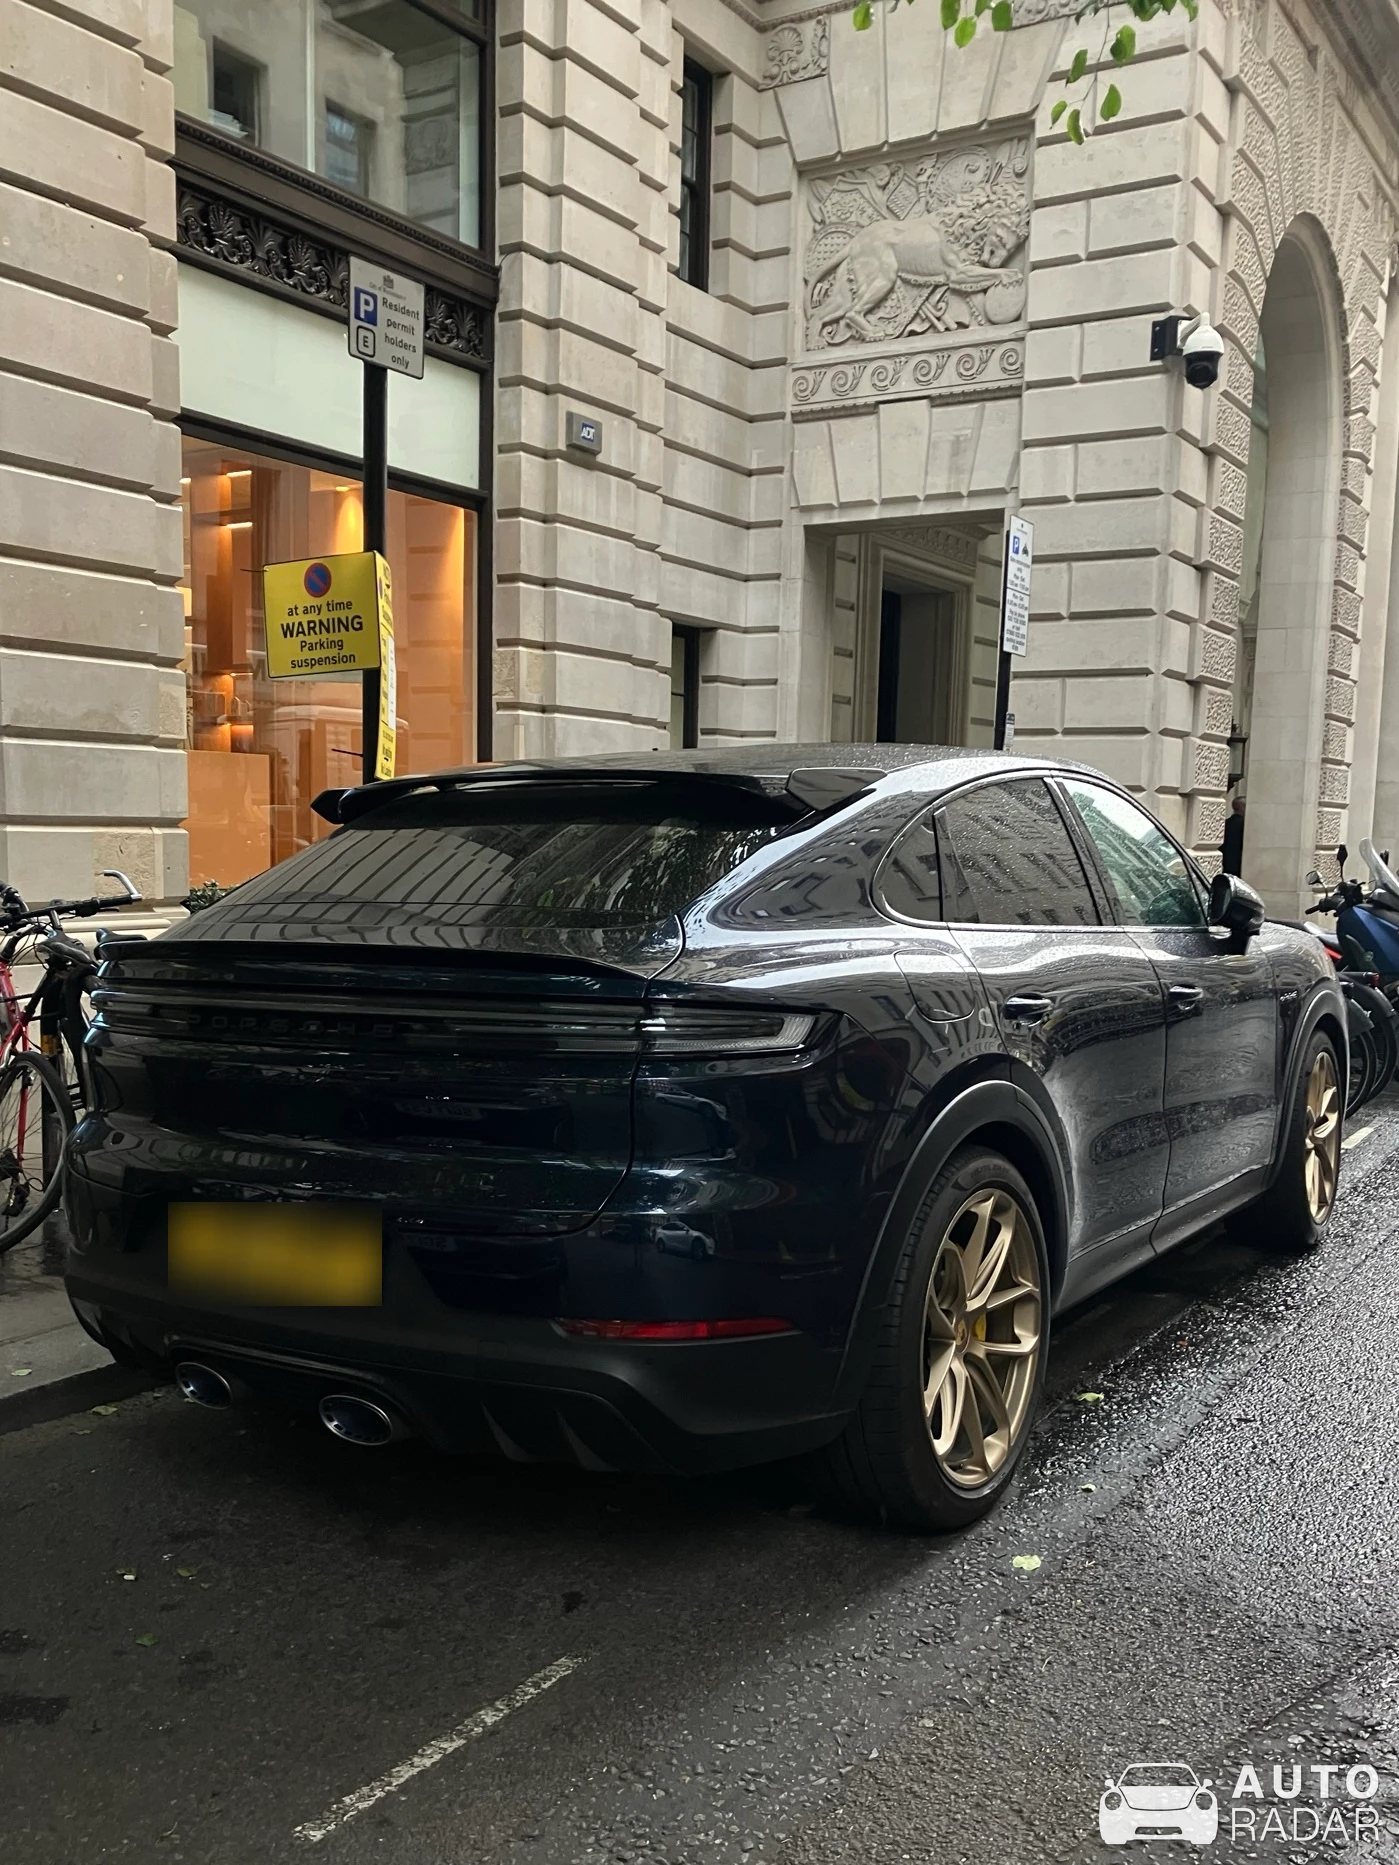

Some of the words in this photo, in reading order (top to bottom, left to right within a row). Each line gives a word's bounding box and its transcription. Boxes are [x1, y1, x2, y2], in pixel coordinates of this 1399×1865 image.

[360, 292, 375, 319] P
[382, 297, 419, 320] Resident
[387, 318, 415, 336] permit
[363, 336, 369, 348] E
[385, 332, 416, 353] holders
[391, 354, 410, 369] only
[581, 426, 595, 440] ADT
[287, 604, 299, 616] at
[303, 604, 322, 615] any
[326, 600, 353, 612] time
[281, 615, 363, 638] WARNING
[300, 638, 344, 652] Parking
[291, 653, 356, 669] suspension
